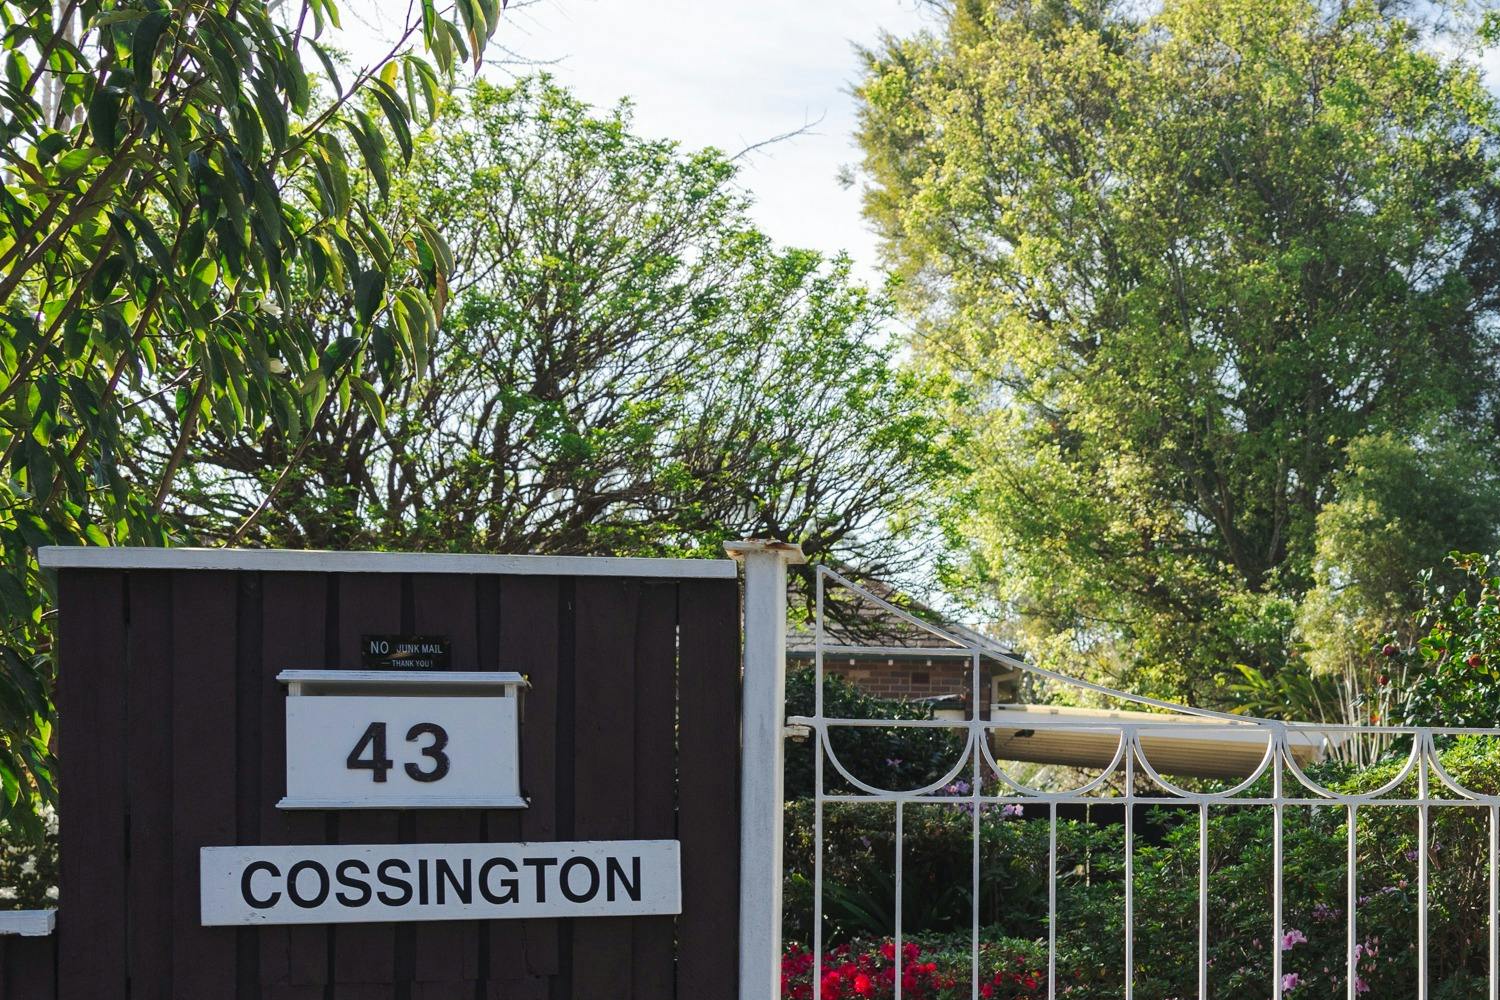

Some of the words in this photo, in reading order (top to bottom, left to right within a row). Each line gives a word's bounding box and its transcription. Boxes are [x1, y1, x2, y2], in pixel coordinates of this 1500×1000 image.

[370, 641, 389, 654] NO
[396, 644, 419, 653] JUNK
[422, 644, 443, 654] MAIL
[392, 659, 413, 667] THANK
[346, 721, 450, 783] 43
[240, 856, 642, 909] COSSINGTON
